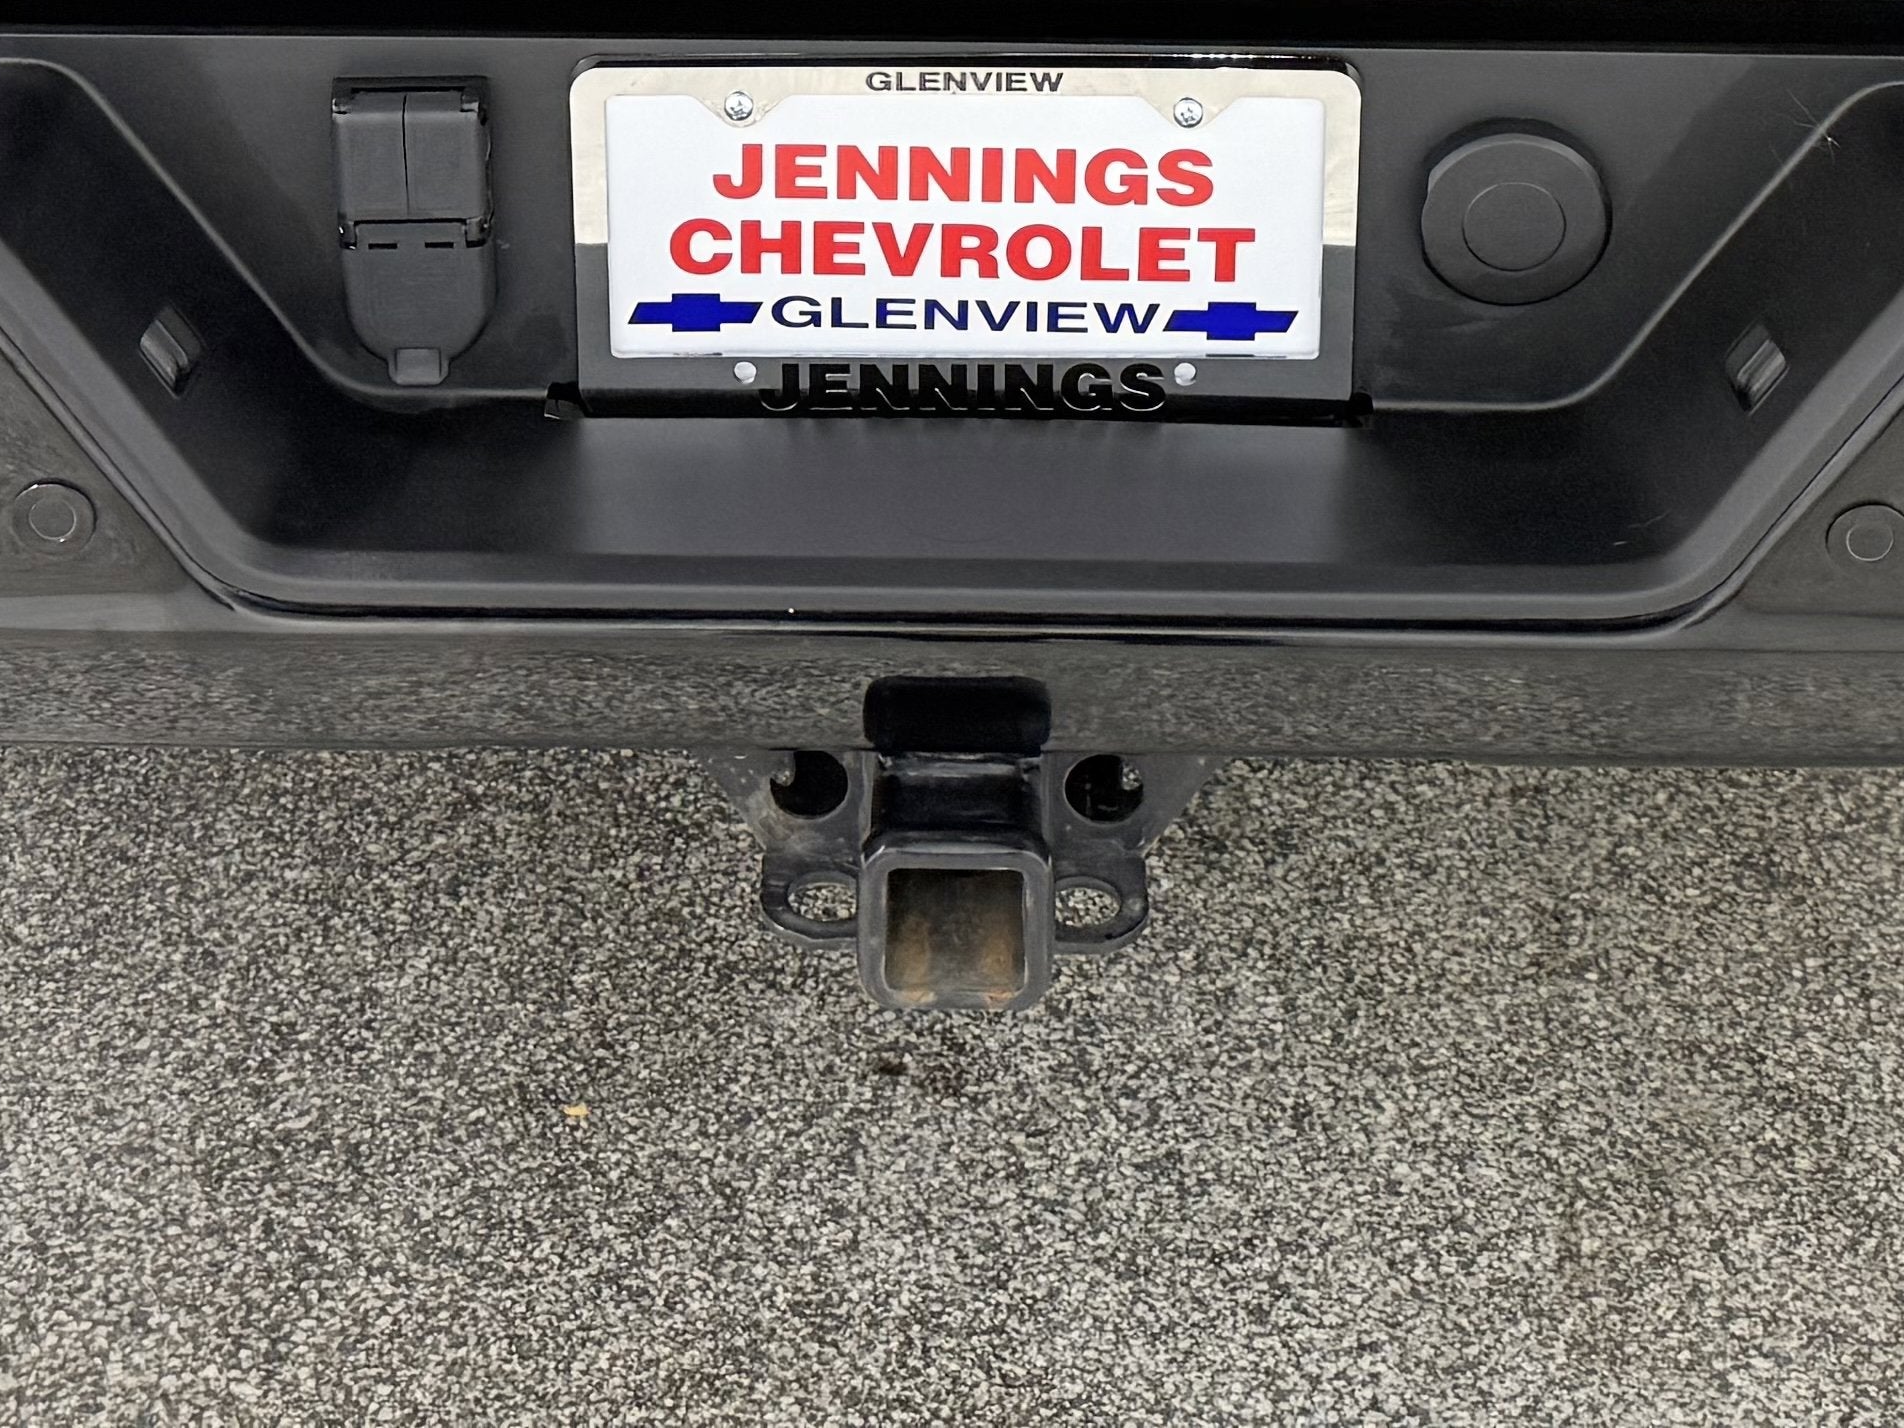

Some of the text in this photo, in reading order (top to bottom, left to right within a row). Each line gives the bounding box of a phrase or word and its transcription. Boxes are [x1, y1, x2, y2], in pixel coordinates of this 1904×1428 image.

[865, 71, 1064, 93] GLENVIEW
[712, 144, 1214, 206] JENNINGS
[670, 218, 1254, 282] CHEVROLET
[772, 296, 1160, 333] GLENVIEW
[757, 362, 1168, 414] JENNINGS
